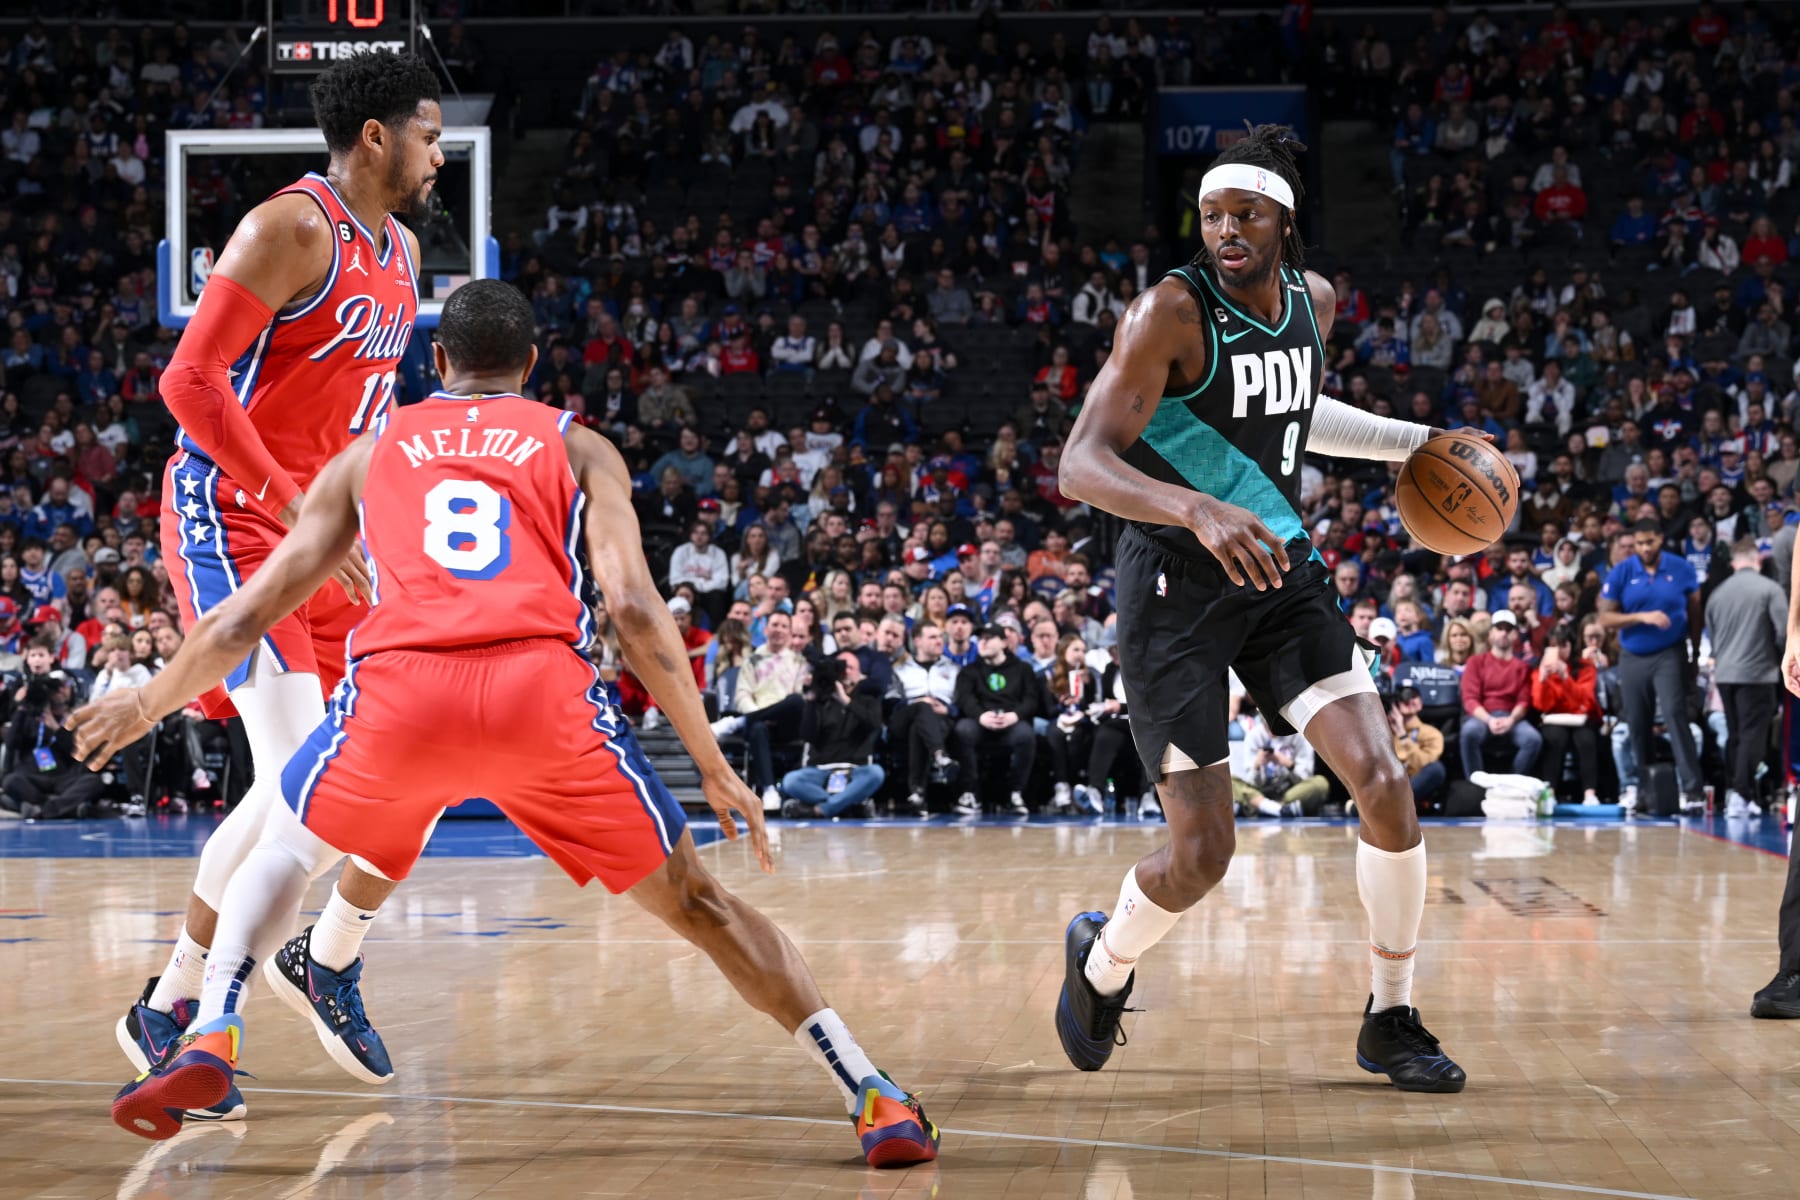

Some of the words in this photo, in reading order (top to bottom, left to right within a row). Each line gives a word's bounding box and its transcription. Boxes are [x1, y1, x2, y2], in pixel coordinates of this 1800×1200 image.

[312, 41, 405, 60] TISSOT
[1165, 125, 1211, 150] 107
[338, 223, 351, 241] 6
[1214, 307, 1229, 323] 6
[349, 370, 396, 434] 12
[1231, 346, 1312, 418] PDX
[396, 428, 545, 468] MELTON
[1281, 421, 1300, 477] 9
[424, 479, 512, 581] 8
